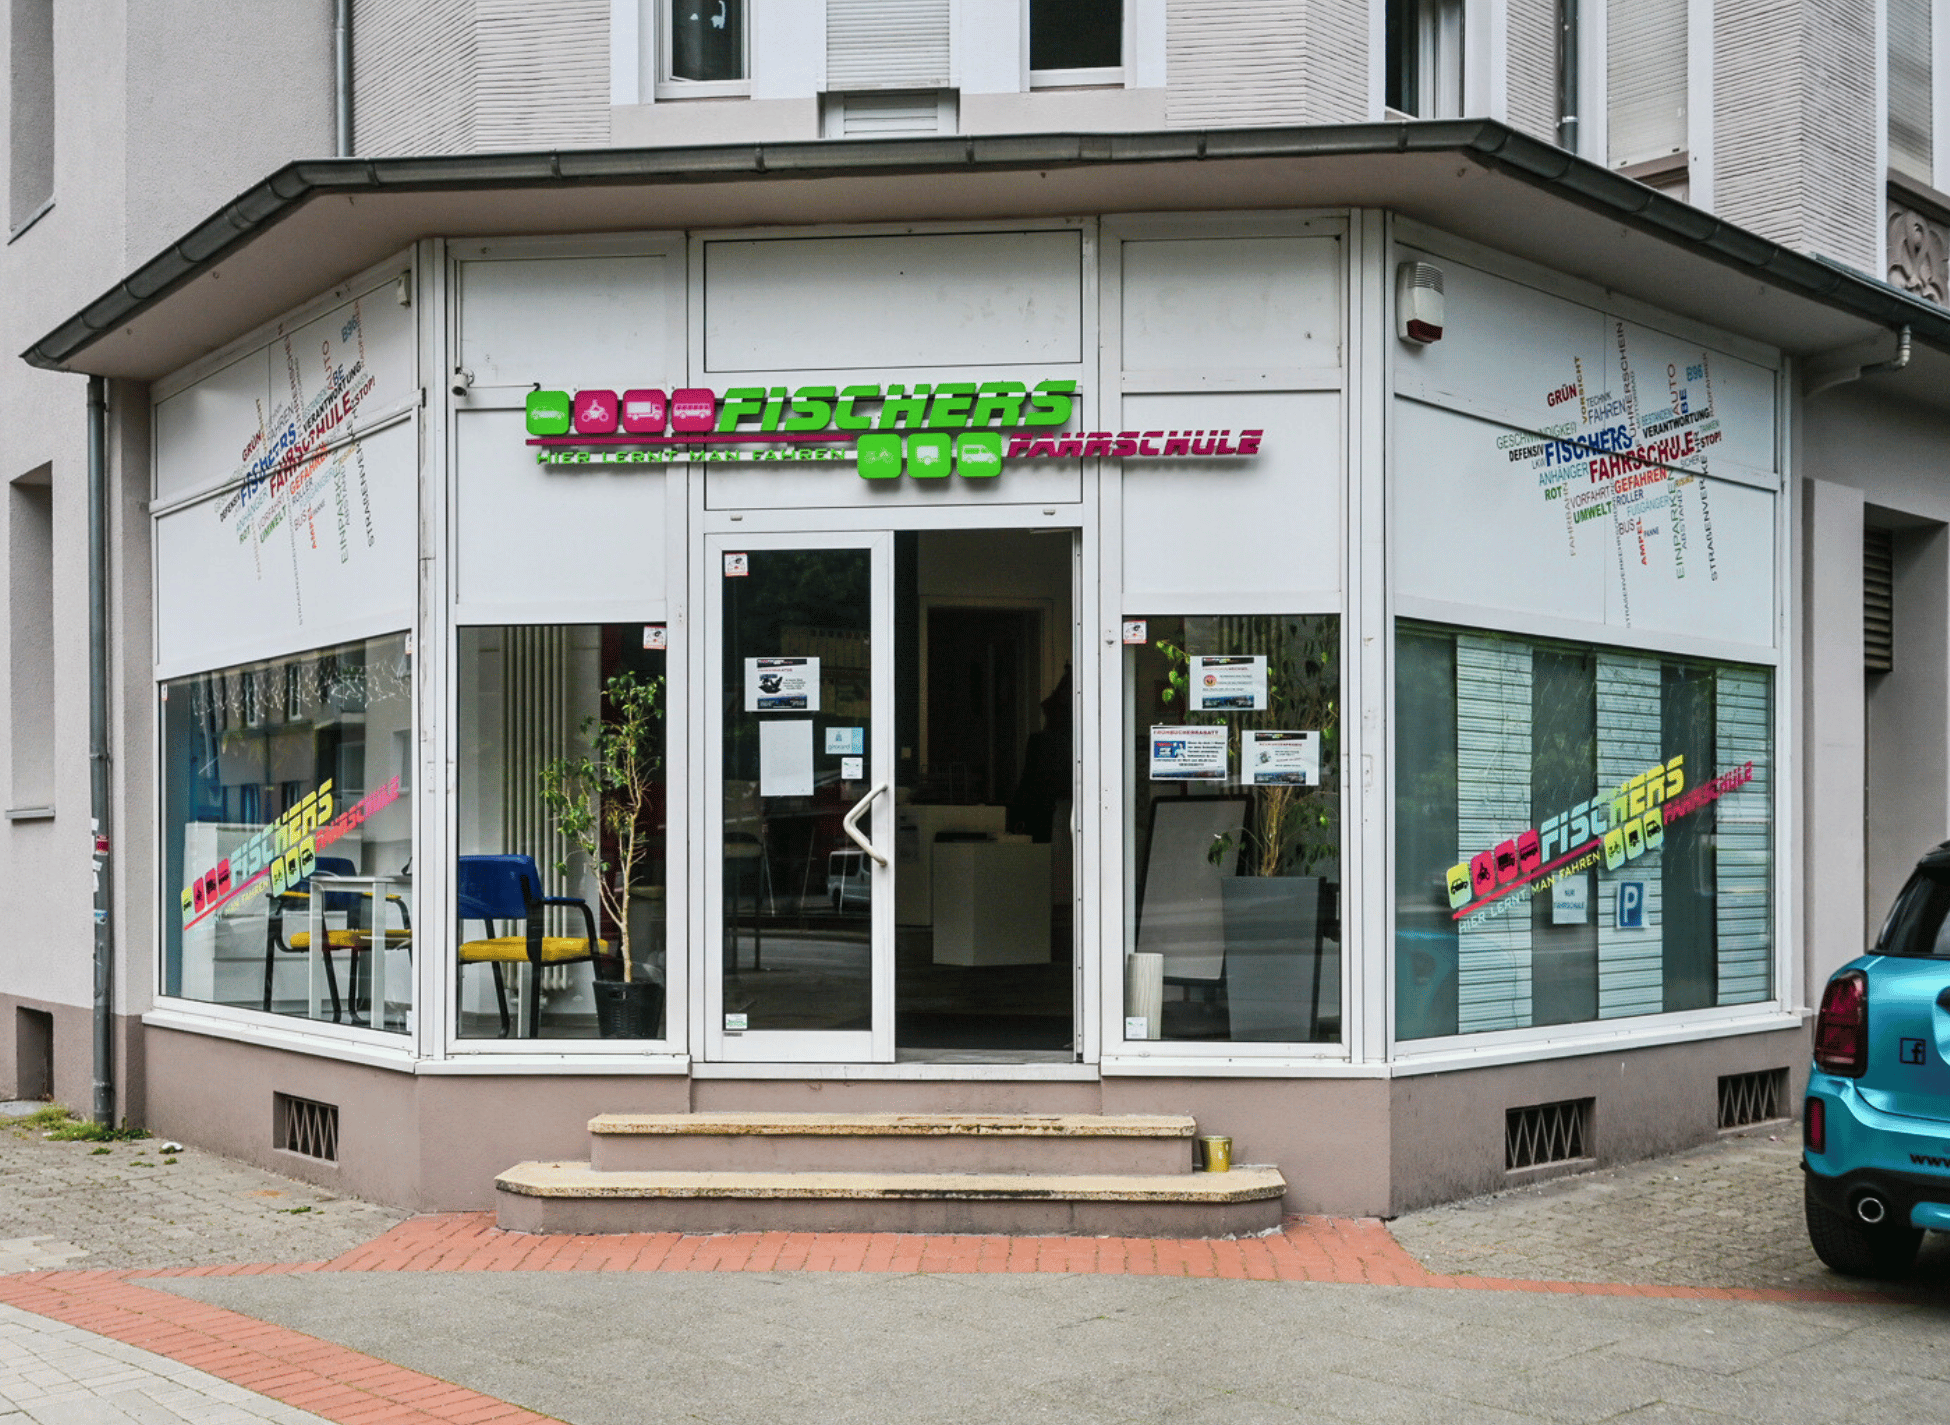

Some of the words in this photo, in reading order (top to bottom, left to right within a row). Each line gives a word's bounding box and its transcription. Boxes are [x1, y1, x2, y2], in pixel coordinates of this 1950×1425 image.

[1546, 383, 1578, 407] GRÜN
[1574, 356, 1587, 424] VORSICHT
[1667, 363, 1680, 416] AUTO
[717, 380, 1077, 432] FISCHERS
[1588, 398, 1627, 425] FAHREN
[1643, 406, 1711, 439] VERANTWORTUNG
[1006, 429, 1264, 458] FAHRSCHULE
[1508, 444, 1544, 463] DEFENSIV
[1545, 424, 1633, 467] FISCHERS
[1700, 431, 1722, 449] STOP!
[537, 451, 591, 465] HIER
[602, 450, 677, 464] LERNT
[689, 449, 741, 463] MAN
[752, 447, 847, 462] FAHREN
[1588, 430, 1696, 484] FAHRSCHULE
[1539, 461, 1590, 487] ANHÄNGER
[1613, 467, 1668, 495] GEFAHREN
[1545, 485, 1562, 501] ROT
[1570, 486, 1611, 509] VORFAHRT
[1573, 501, 1613, 525] UMWELT
[1618, 518, 1636, 536] BUS
[1635, 516, 1648, 566] AMPEL
[1540, 754, 1685, 863] FISCHERS
[230, 777, 334, 888] FISCHERS
[1531, 875, 1556, 896] MAN
[1559, 850, 1601, 880] FAHREN
